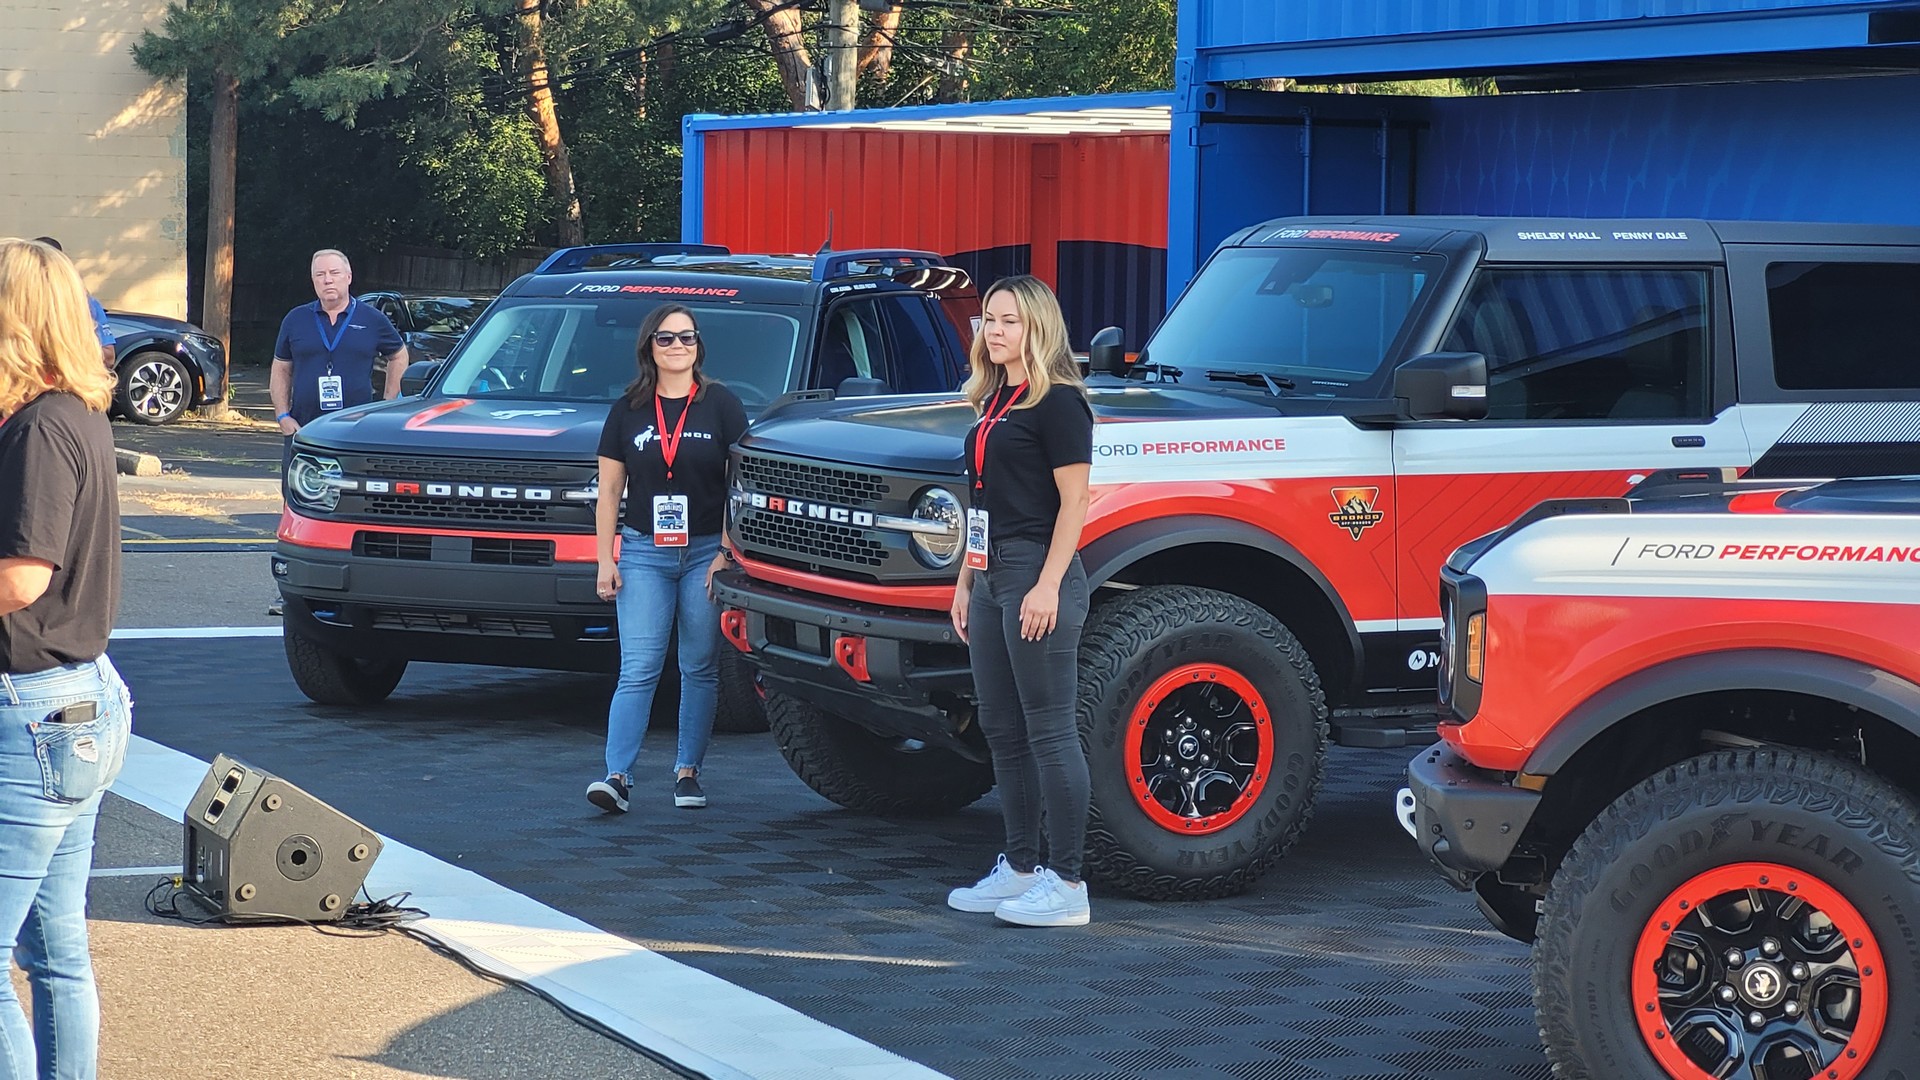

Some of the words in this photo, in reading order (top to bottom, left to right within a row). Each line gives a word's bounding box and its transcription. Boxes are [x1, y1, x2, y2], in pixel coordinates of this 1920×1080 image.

[1274, 230, 1308, 238] FORD
[1303, 230, 1400, 242] PERFORMANCE
[1517, 232, 1565, 240] SHELBY
[1568, 232, 1601, 240] HALL
[1613, 232, 1653, 240] PENNY
[1656, 232, 1688, 240] DALE
[580, 285, 621, 293] FORD
[619, 285, 740, 297] PERFORMANCE
[653, 431, 712, 441] BNCO
[1142, 438, 1286, 456] PERFORMANCE
[365, 480, 552, 501] BRONCO
[751, 493, 874, 527] BRONCO
[1638, 544, 1715, 559] FORD
[1718, 545, 1920, 563] PERFORMANC
